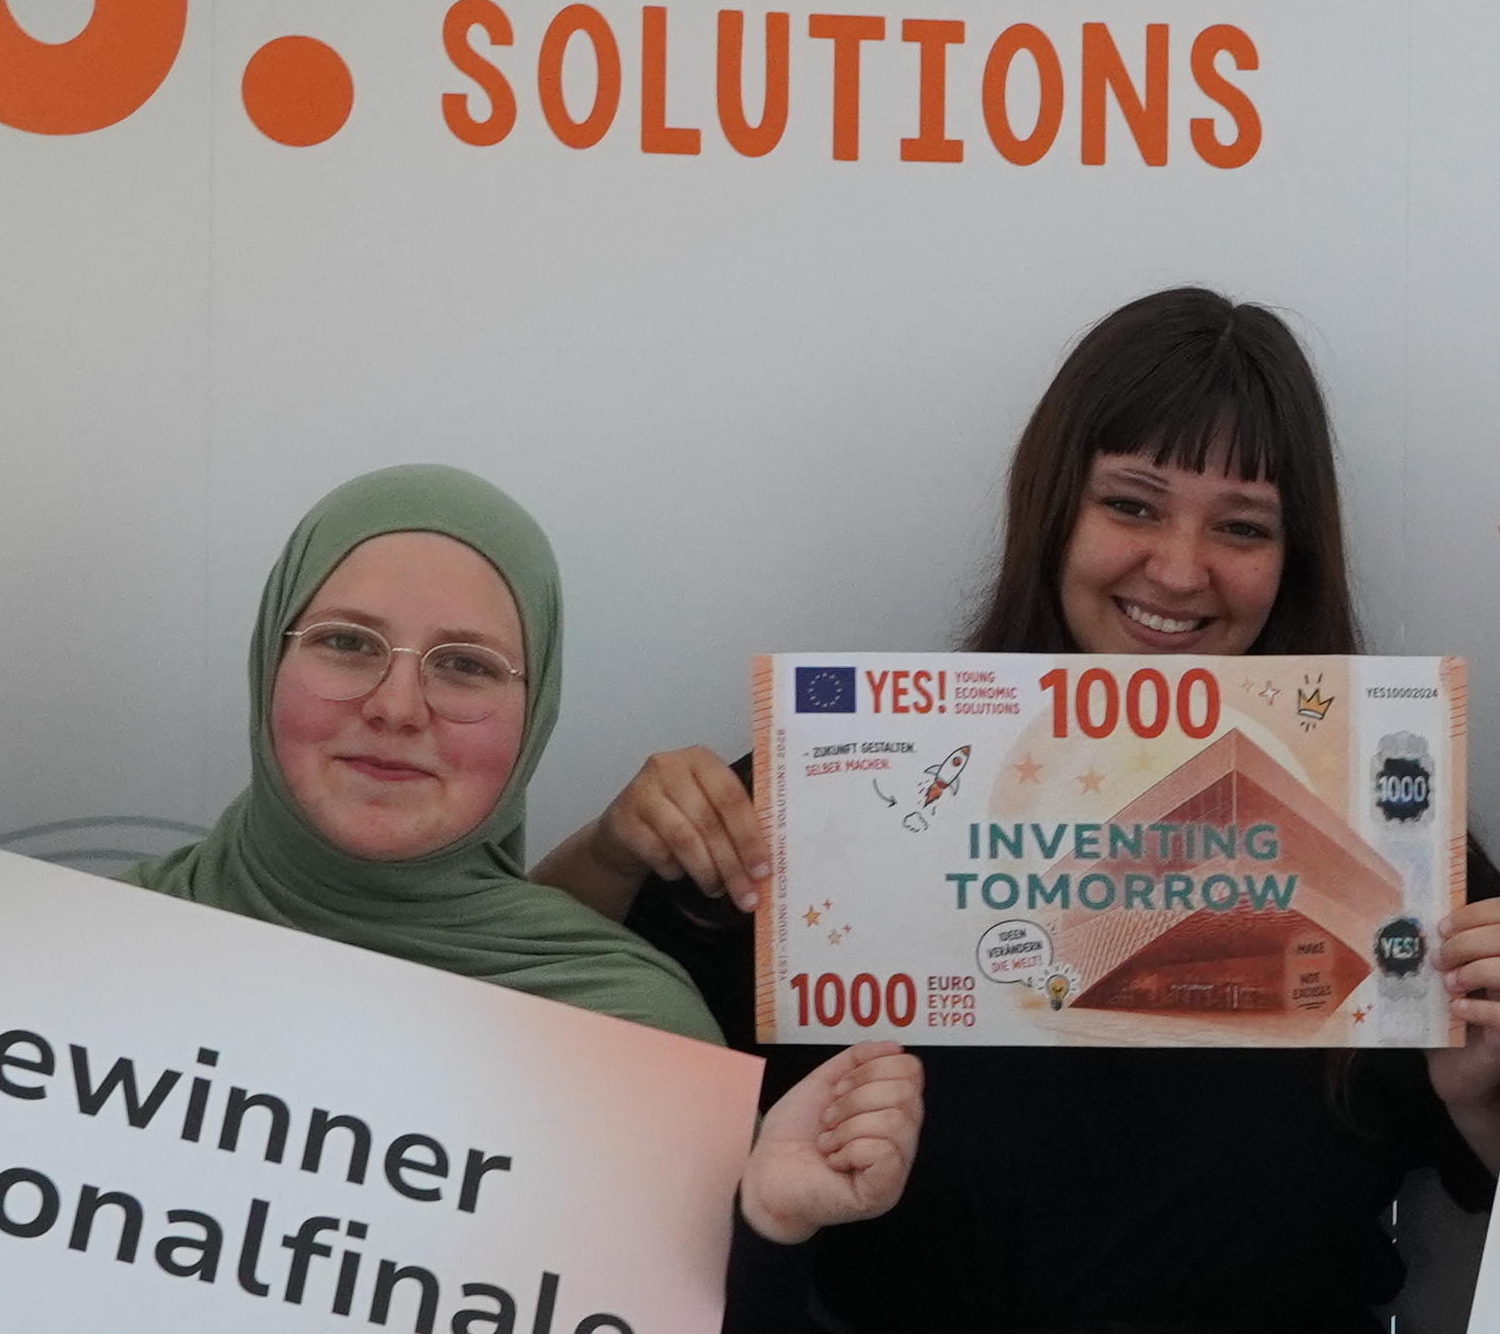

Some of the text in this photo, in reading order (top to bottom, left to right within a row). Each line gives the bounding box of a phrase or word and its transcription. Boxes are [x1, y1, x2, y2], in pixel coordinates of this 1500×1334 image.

[864, 669, 947, 715] YES!
[954, 671, 996, 684] YOUNG
[954, 686, 1018, 700] ECONOMIC
[1038, 667, 1221, 740] 1000
[954, 702, 1021, 716] SOLUTIONS
[1378, 774, 1428, 804] 1000
[968, 822, 1280, 861] INVENTING
[945, 873, 1299, 912] TOMORROW
[1380, 936, 1420, 960] YES!
[927, 975, 977, 992] EURO
[790, 971, 918, 1029] 1000
